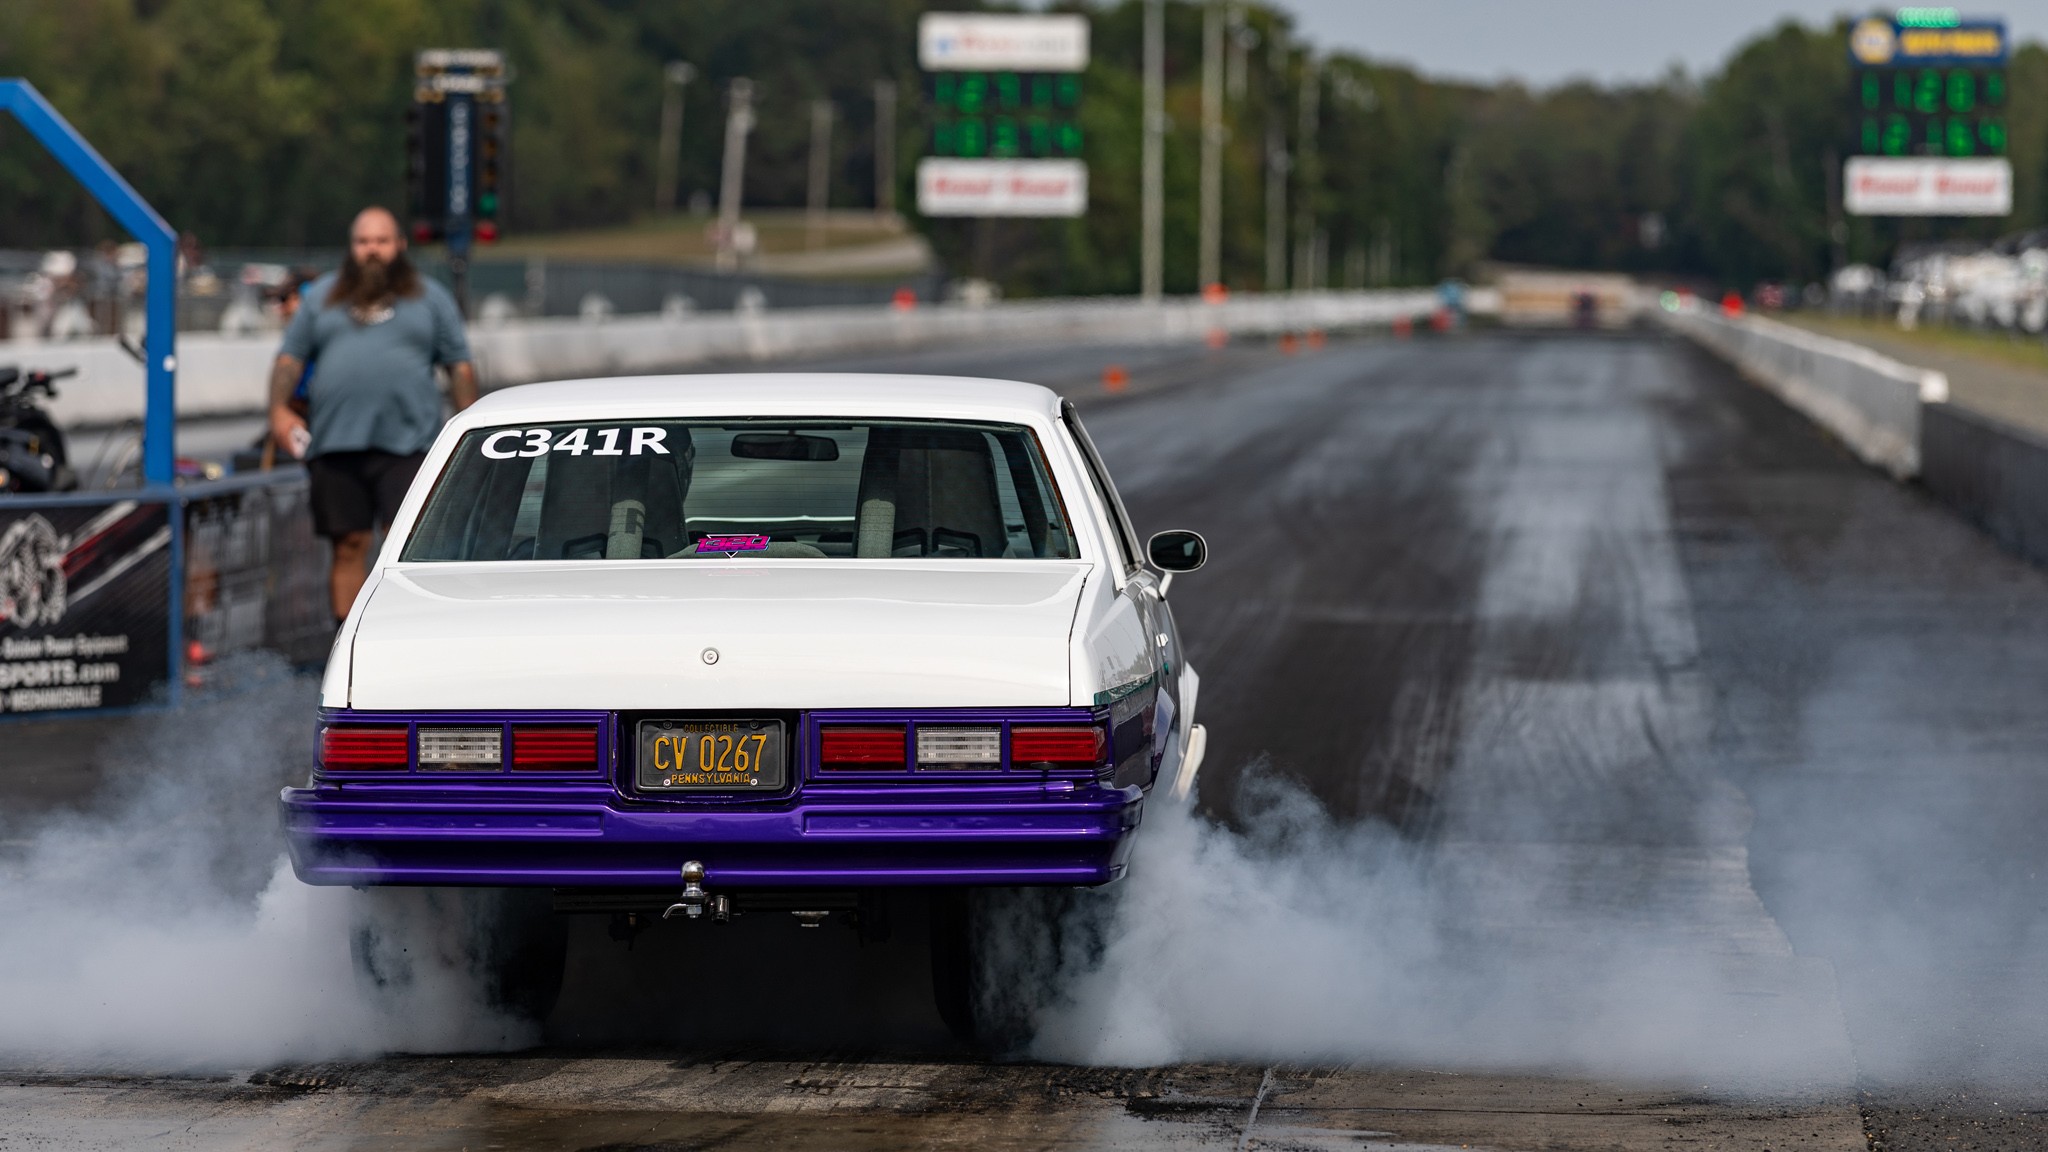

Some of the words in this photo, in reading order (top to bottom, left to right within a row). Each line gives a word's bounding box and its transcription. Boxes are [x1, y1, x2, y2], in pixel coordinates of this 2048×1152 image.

[481, 427, 671, 460] C341R
[683, 723, 739, 733] COLLECTIBLE
[654, 736, 688, 770] CV
[699, 733, 767, 772] 0267
[671, 773, 751, 784] PENNSYLVANIA
